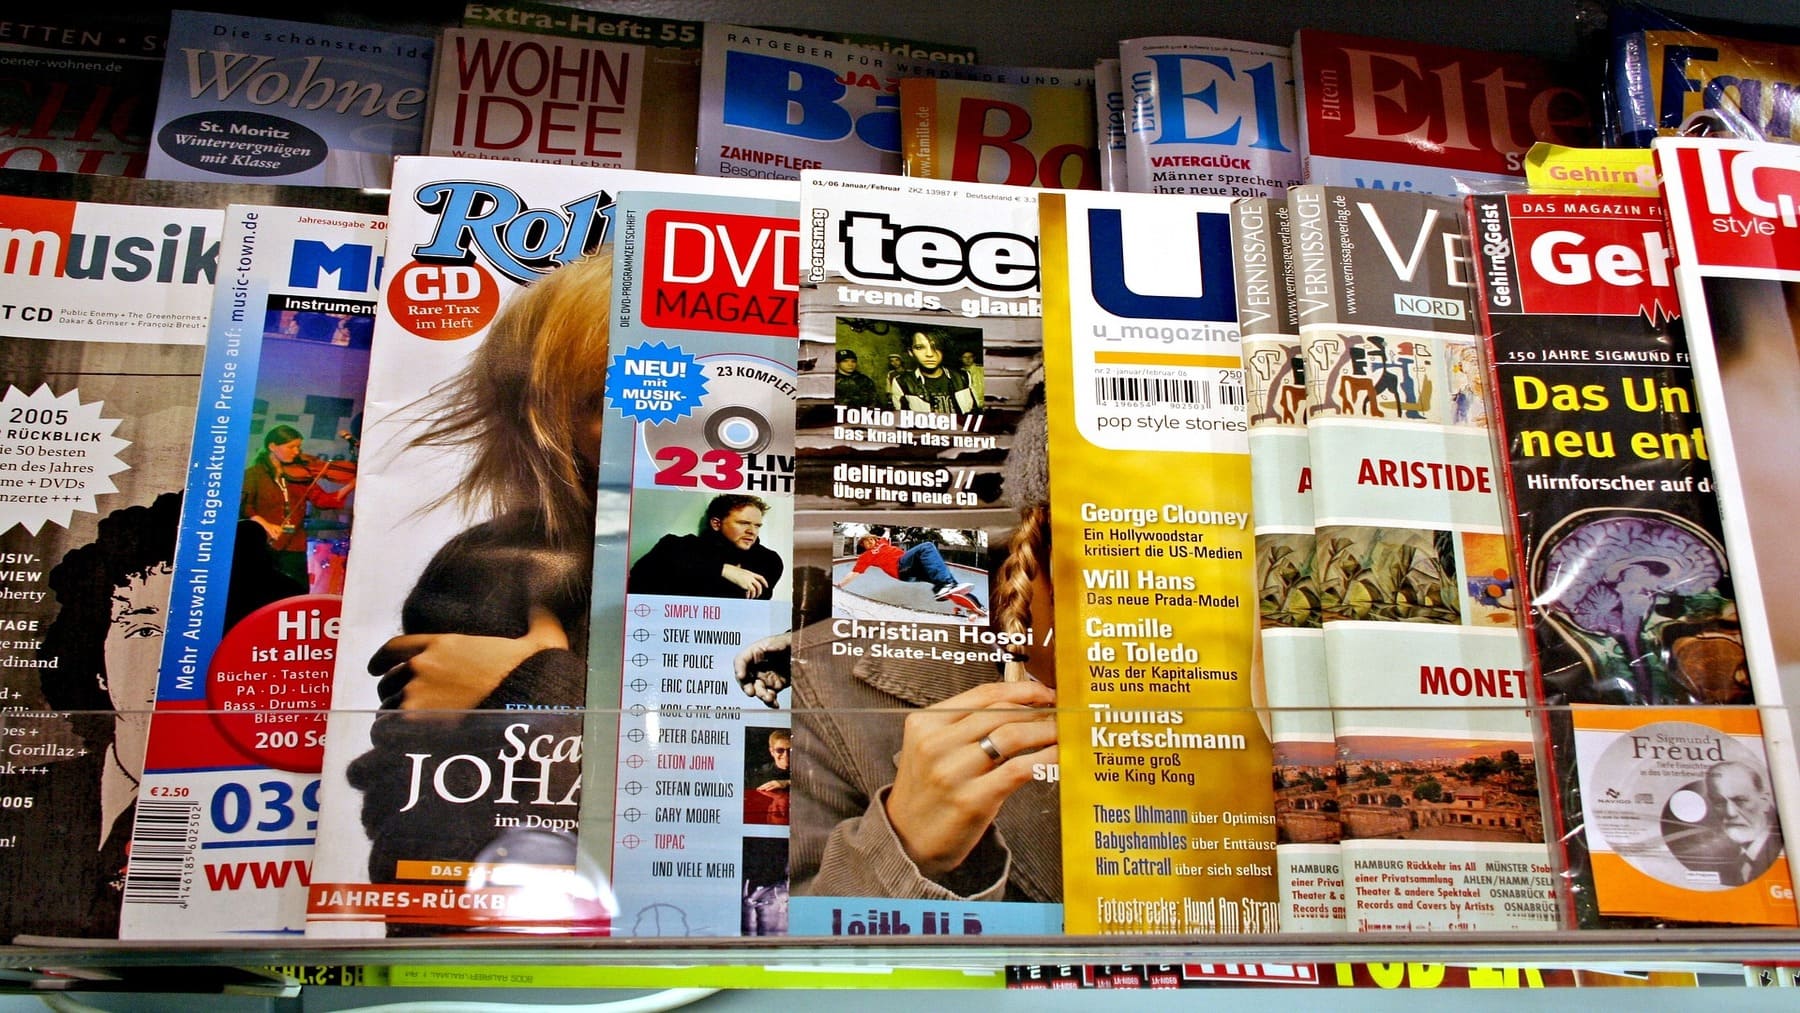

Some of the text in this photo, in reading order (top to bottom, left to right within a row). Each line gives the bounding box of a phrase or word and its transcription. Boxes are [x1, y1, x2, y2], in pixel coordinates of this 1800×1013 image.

[465, 4, 696, 43] Extra-Heft: 55
[213, 25, 383, 55] Die schönsten
[727, 33, 834, 60] RATGEBER
[847, 53, 884, 69] FÜR
[456, 36, 630, 105] WOHN
[180, 47, 428, 121] Wohne
[1132, 71, 1155, 133] Eltern
[1321, 69, 1342, 121] Eltern
[199, 120, 290, 140] St. Moritz
[452, 93, 623, 158] IDEE
[174, 133, 312, 159] Wintervergnügen
[199, 153, 281, 170] mit Klasse
[720, 146, 823, 172] ZAHNPFLEGE
[1151, 155, 1251, 171] VATERGLÜCK
[841, 182, 901, 192] Januar/Februar
[1152, 172, 1283, 188] Männer sprechen
[1522, 203, 1641, 216] DAS MAGAZIN
[297, 216, 366, 229] Jahresausgabe
[1712, 217, 1776, 237] style
[808, 207, 829, 283] teensmag
[839, 210, 1040, 292] tee
[1240, 200, 1272, 328] VERNISSAGE
[1296, 193, 1329, 317] VERNISSAGE
[1332, 195, 1357, 315] www.vernissageverlag.de
[1481, 203, 1512, 307] Gehirn&Geist
[403, 266, 482, 302] CD
[837, 285, 942, 310] trends
[21, 306, 53, 322] CD
[90, 310, 120, 319] Enemy
[408, 304, 480, 316] Rare Trax
[1399, 298, 1460, 317] NORD
[59, 317, 85, 325] Dakar
[441, 318, 473, 329] Heft
[1508, 350, 1670, 363] 150 JAHRE SIGMUND
[624, 359, 688, 378] NEU!
[716, 366, 733, 377] 23
[643, 378, 668, 388] mit
[622, 388, 687, 401] MUSIK-
[1513, 376, 1610, 412] Das
[635, 401, 673, 411] DVD
[9, 407, 69, 425] 2005
[834, 405, 958, 431] Tokio Hotel
[1097, 415, 1247, 432] pop style stories
[7, 428, 102, 442] RÜCKBLICK
[834, 427, 996, 449] Das knallt, nervt
[1520, 429, 1616, 458] neu
[16, 445, 86, 458] 50 besten
[176, 212, 259, 690] Mehr Auswahl und tagesaktuelle Preise music-town.de
[49, 463, 94, 474] Jahres
[654, 446, 744, 491] 23
[833, 463, 949, 488] delirious?
[1357, 458, 1492, 493] ARISTIDE
[40, 478, 85, 489] DVDs
[1527, 473, 1693, 492] Hirnforscher auf
[833, 482, 978, 506] Über CD
[1081, 502, 1248, 530] George Clooney
[1084, 528, 1204, 543] Ein Hollywoodstar
[1084, 544, 1243, 560] kritisiert US-Medien
[1082, 569, 1196, 591] Will Hans
[1155, 594, 1240, 608] Prada-Model
[664, 603, 721, 620] SIMPLY RED
[663, 628, 741, 646] STEVE WINWOOD
[831, 619, 1033, 646] Christian Hosoi
[1085, 617, 1173, 639] Camille
[251, 645, 333, 663] ist alles
[683, 654, 714, 669] POLICE
[832, 642, 1013, 664] Die Skate-Legende
[1087, 642, 1199, 663] de Toledo
[216, 669, 329, 682] Bücher Tasten
[1089, 665, 1238, 681] Was Kapitalismus
[1420, 665, 1528, 699] MONET
[661, 678, 728, 695] ERIC CLAPTON
[1150, 681, 1191, 693] macht
[269, 699, 317, 710] Drums
[254, 713, 300, 724] Bläser
[254, 731, 298, 749] 200
[658, 728, 731, 746] PETER GABRIEL
[1090, 726, 1246, 750] Kretschmann
[1656, 733, 1712, 745] Sigmund
[9, 743, 75, 757] Gorillaz
[1631, 736, 1726, 762] Freud
[657, 754, 715, 771] ELTON JOHN
[1094, 752, 1181, 768] Träume groß
[1124, 769, 1195, 786] King Kong
[161, 787, 190, 798] 2.50
[655, 781, 734, 798] STEFAN GWILDIS
[655, 807, 721, 824] GARY MOORE
[1093, 804, 1188, 825] Thees Uhlmann
[654, 833, 686, 850] TUPAC
[1094, 831, 1188, 853] Babyshambles
[652, 861, 735, 879] UND VIELE MEHR
[1096, 857, 1273, 877] Kim Cattrall selbst
[1354, 860, 1528, 873] HAMBURG Rückkehr MÜNSTER
[1381, 874, 1454, 886] Privatsammlung
[1356, 886, 1545, 899] Theater andere Spektakel OSNABRÜCK
[1465, 901, 1495, 911] Artists
